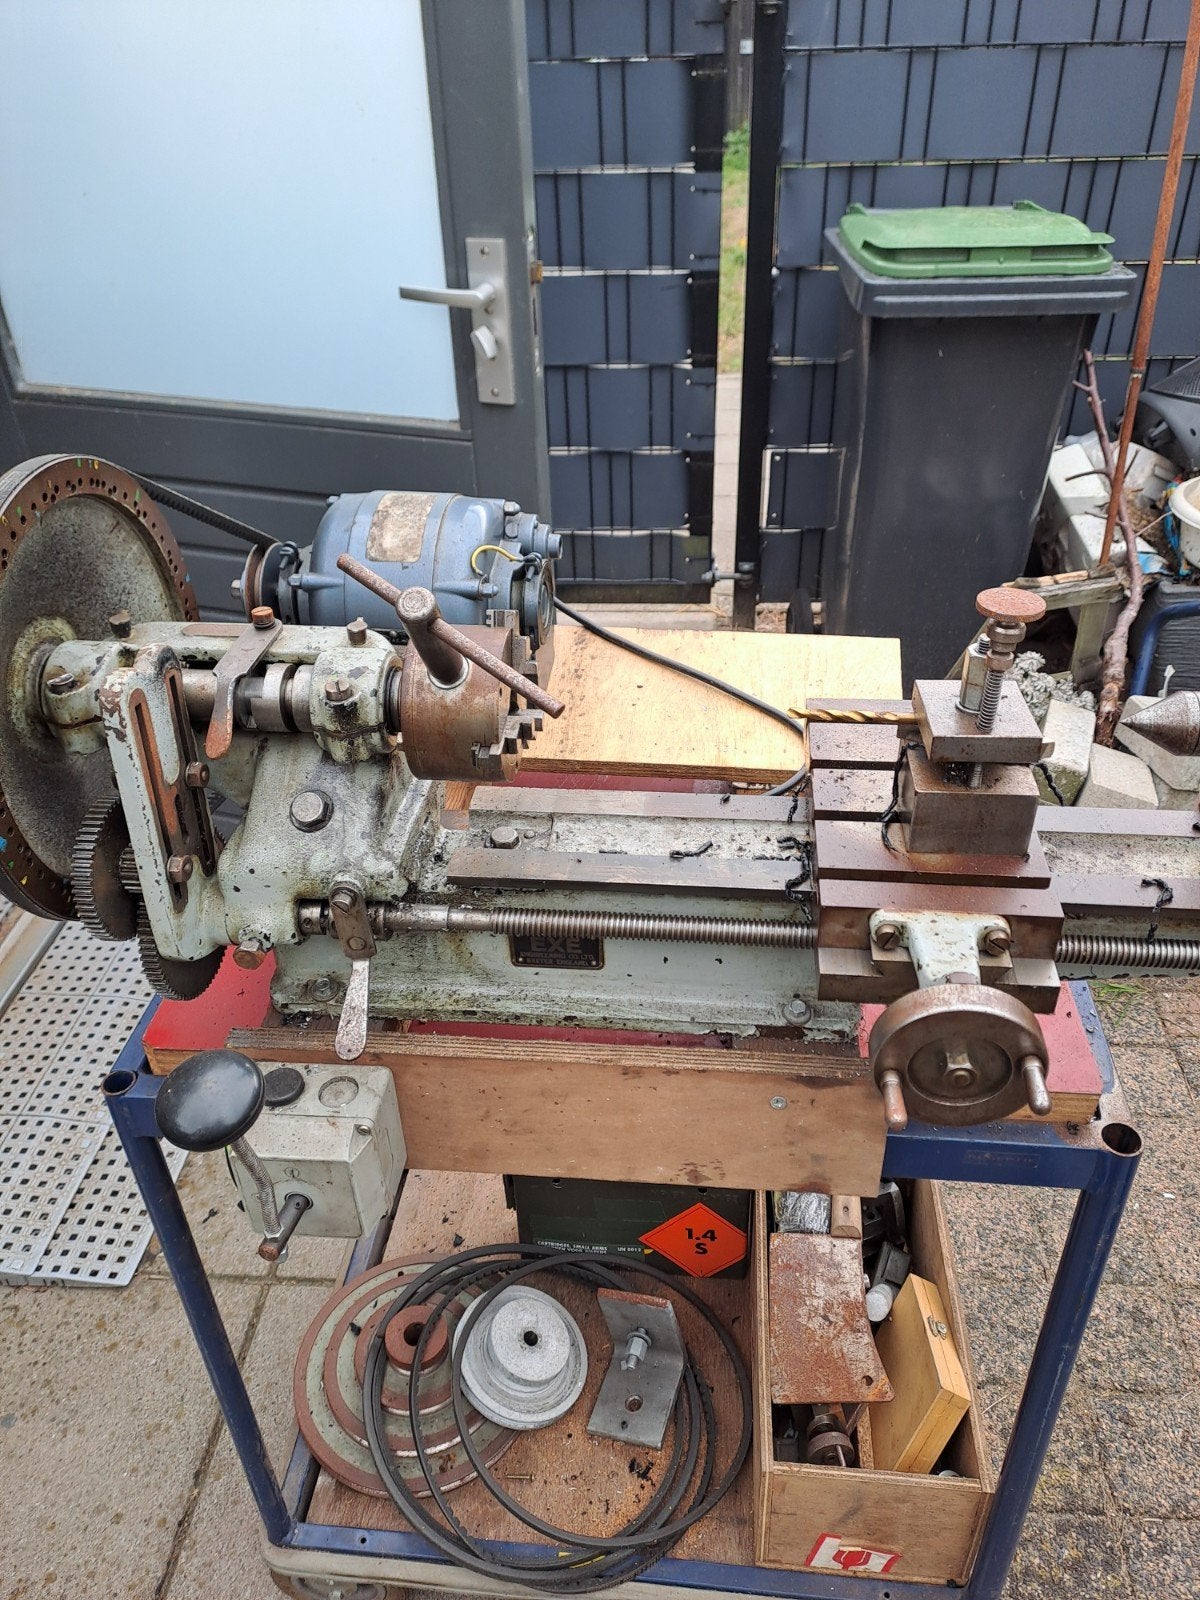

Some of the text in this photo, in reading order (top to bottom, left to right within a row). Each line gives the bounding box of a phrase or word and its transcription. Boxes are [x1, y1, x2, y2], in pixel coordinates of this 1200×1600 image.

[530, 936, 583, 954] EXE
[685, 1228, 717, 1241] 1.4
[695, 1243, 708, 1254] S
